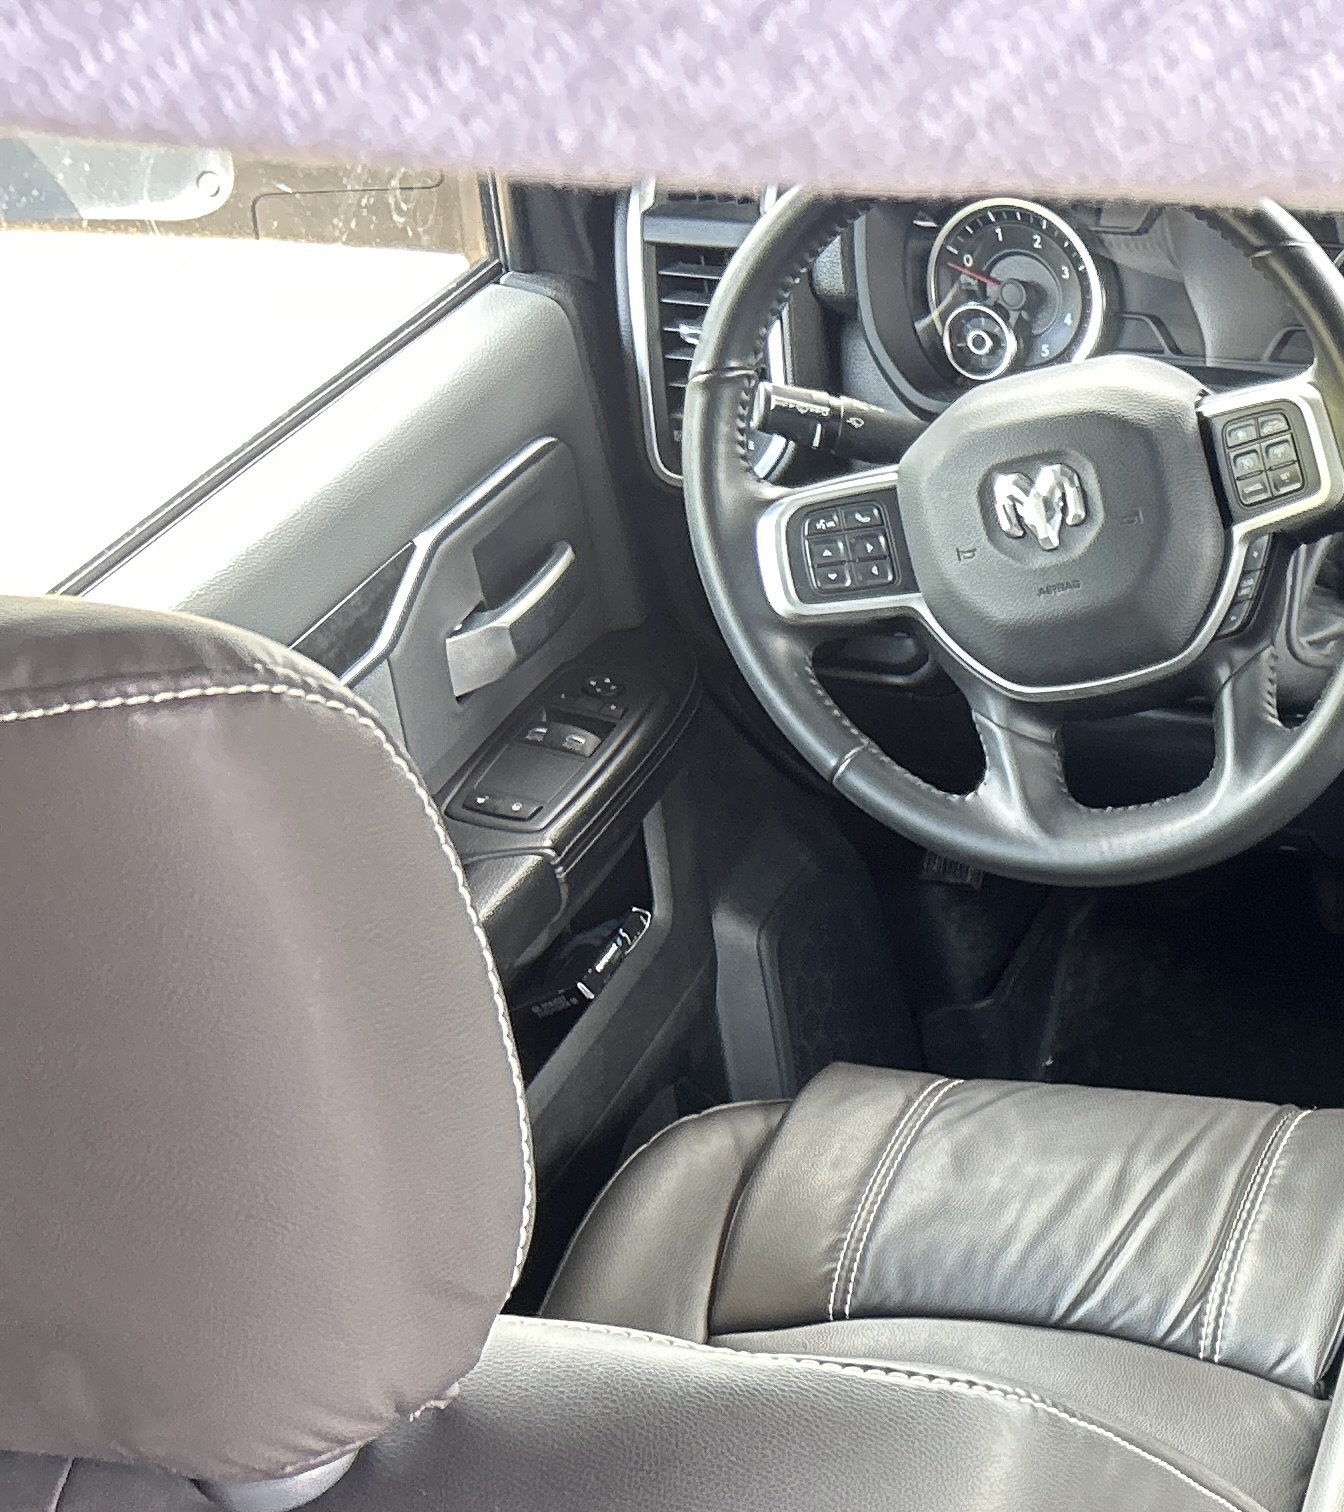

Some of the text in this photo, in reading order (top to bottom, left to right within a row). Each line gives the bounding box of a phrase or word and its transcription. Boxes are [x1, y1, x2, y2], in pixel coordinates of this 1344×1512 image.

[995, 228, 1003, 242] 1
[1033, 235, 1042, 248] 2
[963, 254, 973, 267] 0
[1061, 265, 1070, 279] 3
[1064, 313, 1072, 326] 4
[1041, 344, 1050, 357] 5
[1037, 580, 1080, 597] AIRBAG
